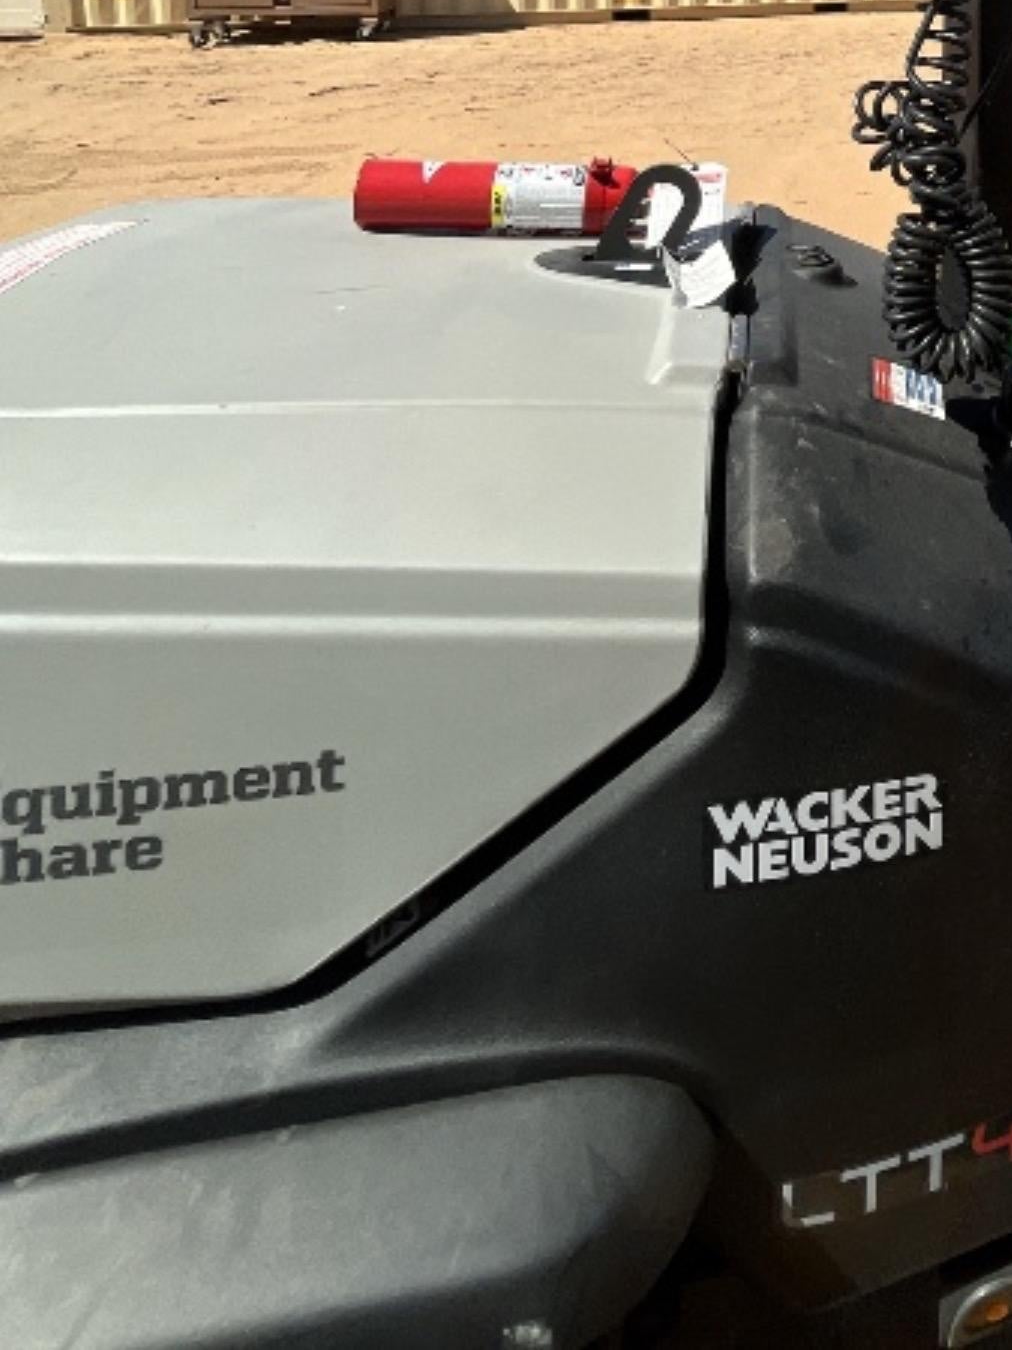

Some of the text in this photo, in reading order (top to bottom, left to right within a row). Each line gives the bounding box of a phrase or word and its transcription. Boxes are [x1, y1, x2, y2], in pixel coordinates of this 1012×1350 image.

[1, 749, 346, 835] quipment
[707, 773, 943, 844] WACKER
[0, 835, 164, 885] hare
[713, 811, 943, 889] NEUSON
